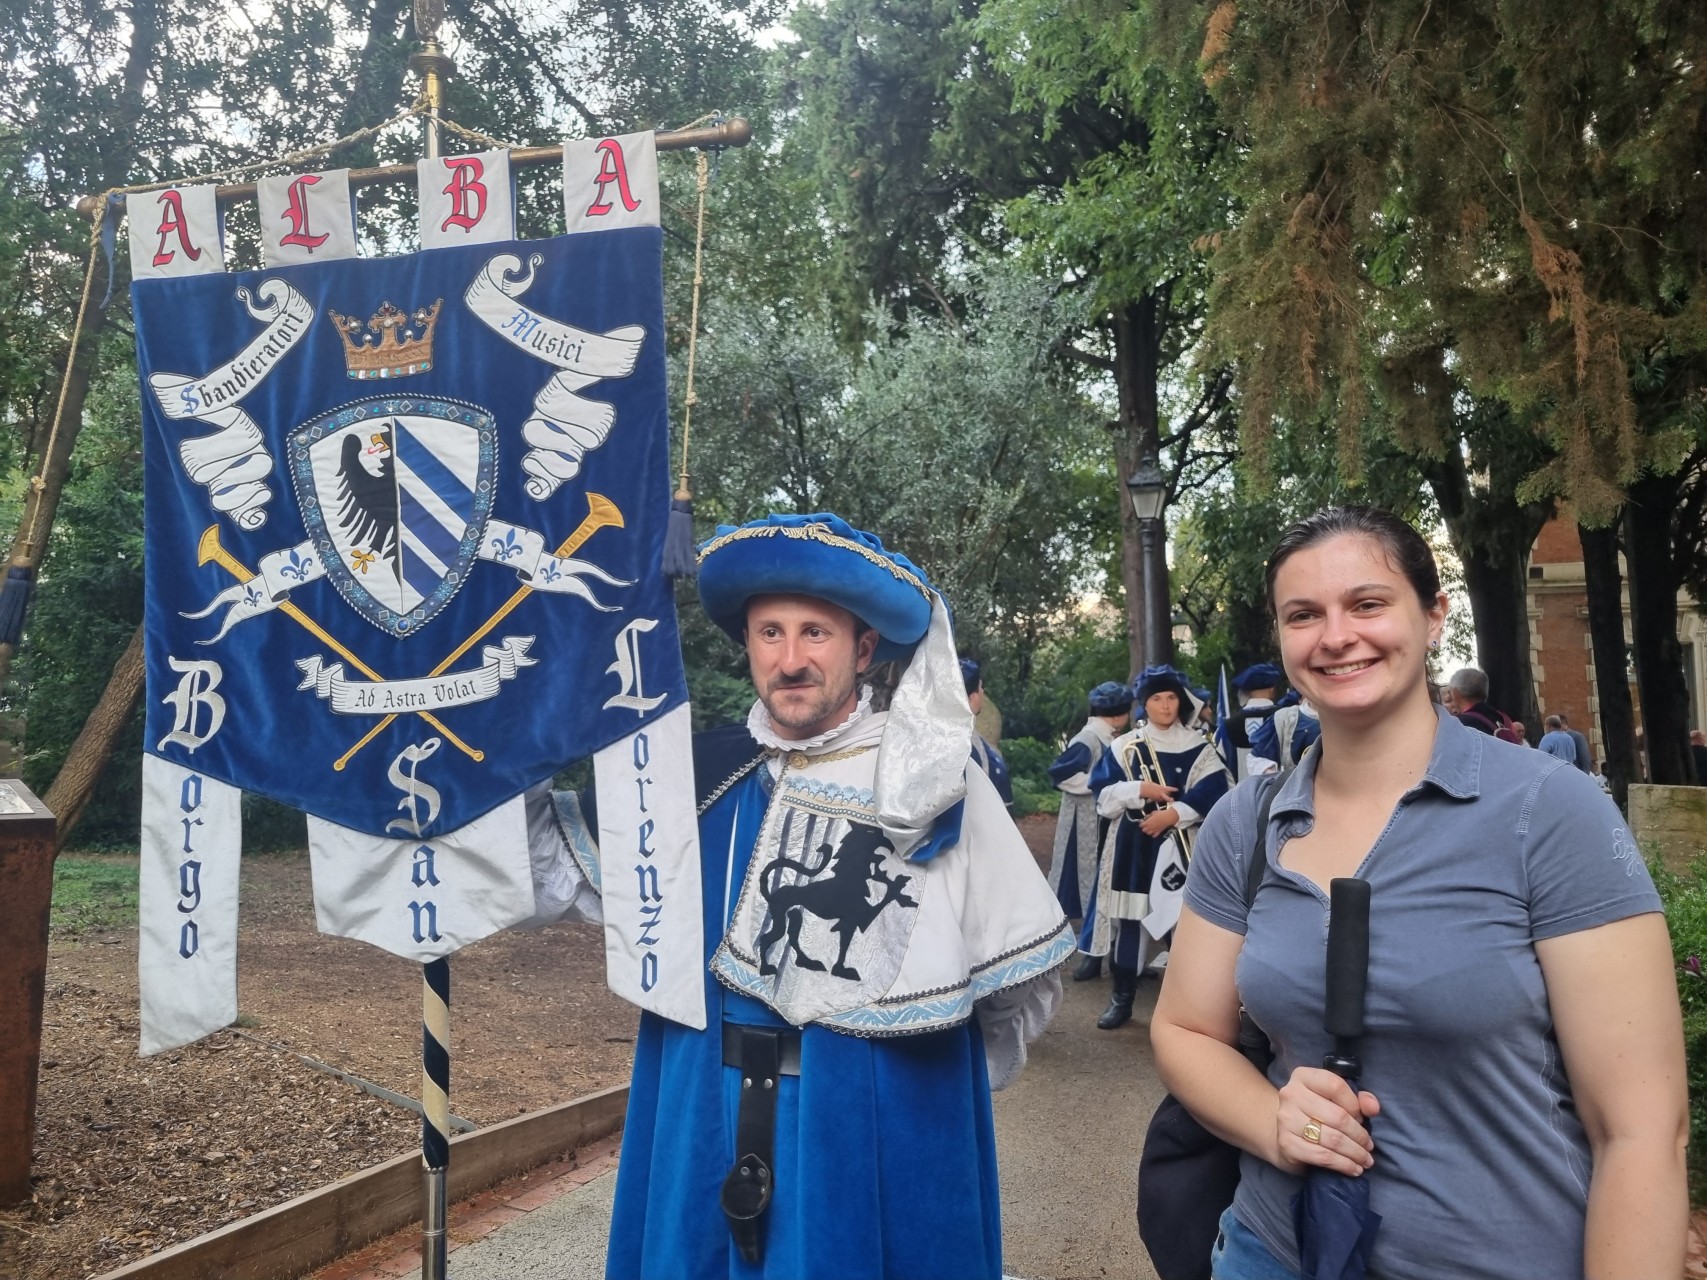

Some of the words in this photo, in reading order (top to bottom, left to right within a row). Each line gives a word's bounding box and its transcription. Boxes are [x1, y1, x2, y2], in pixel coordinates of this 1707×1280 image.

[152, 139, 642, 268] ALBA
[180, 309, 304, 414] Sbandieratori
[501, 308, 587, 364] Musici
[354, 687, 376, 708] Ad
[383, 690, 426, 709] Astra
[432, 679, 477, 702] Volat
[157, 655, 227, 960] Borgo
[385, 737, 443, 945] San
[602, 618, 669, 993] Lorenzo
